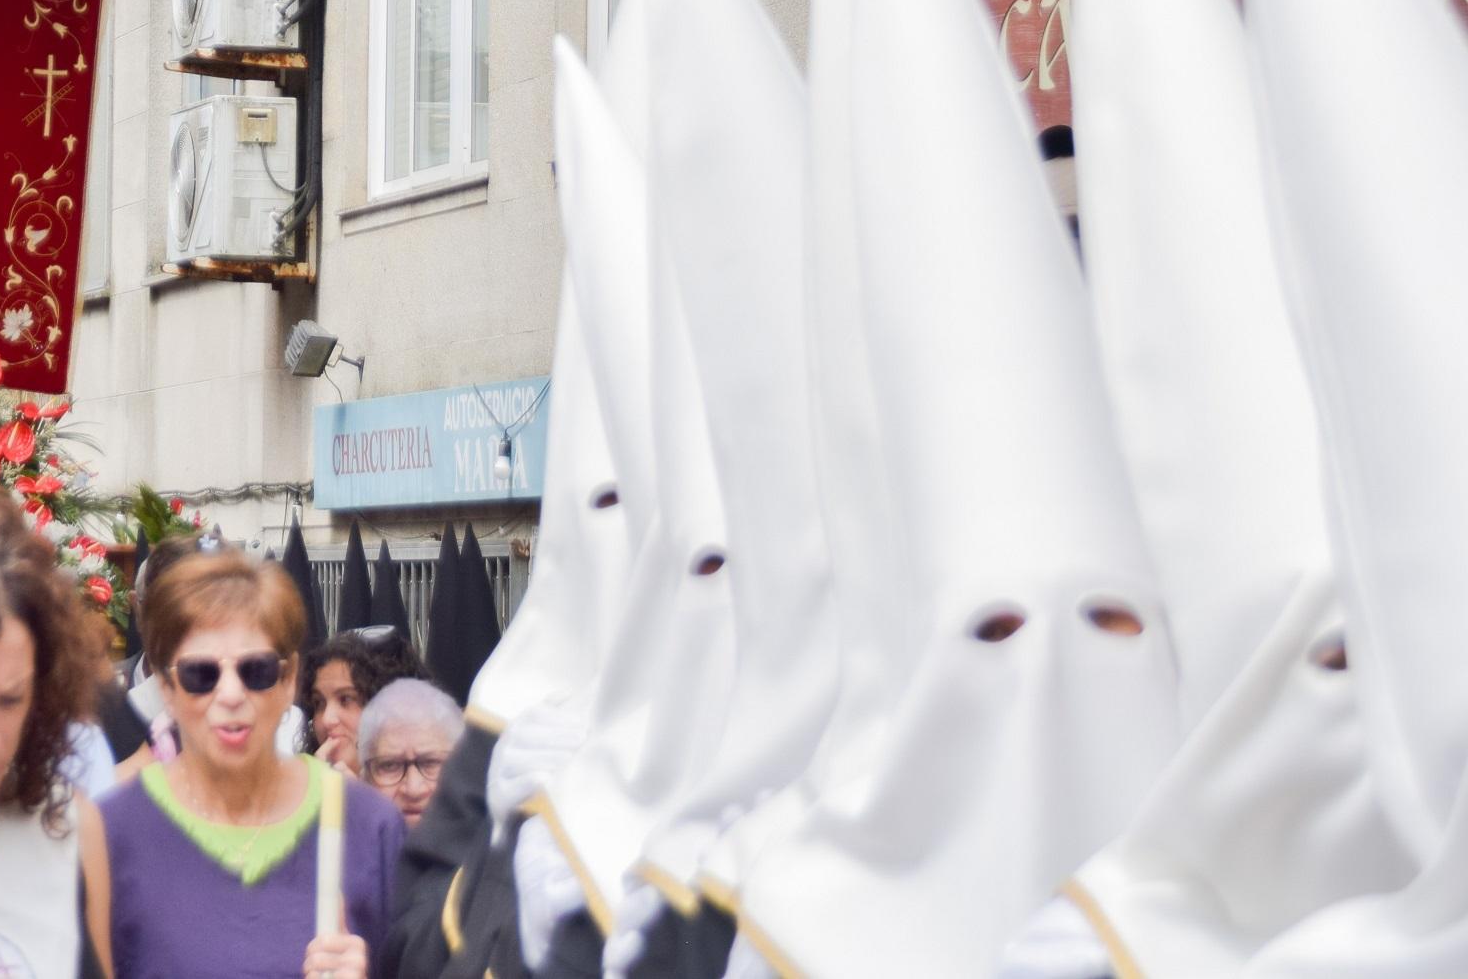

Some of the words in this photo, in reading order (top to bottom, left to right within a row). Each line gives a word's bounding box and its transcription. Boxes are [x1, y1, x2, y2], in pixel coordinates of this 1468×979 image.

[443, 386, 537, 432] AUTOSERVICIO
[332, 425, 434, 476] CHARCUTERIA
[454, 433, 529, 493] MARA
